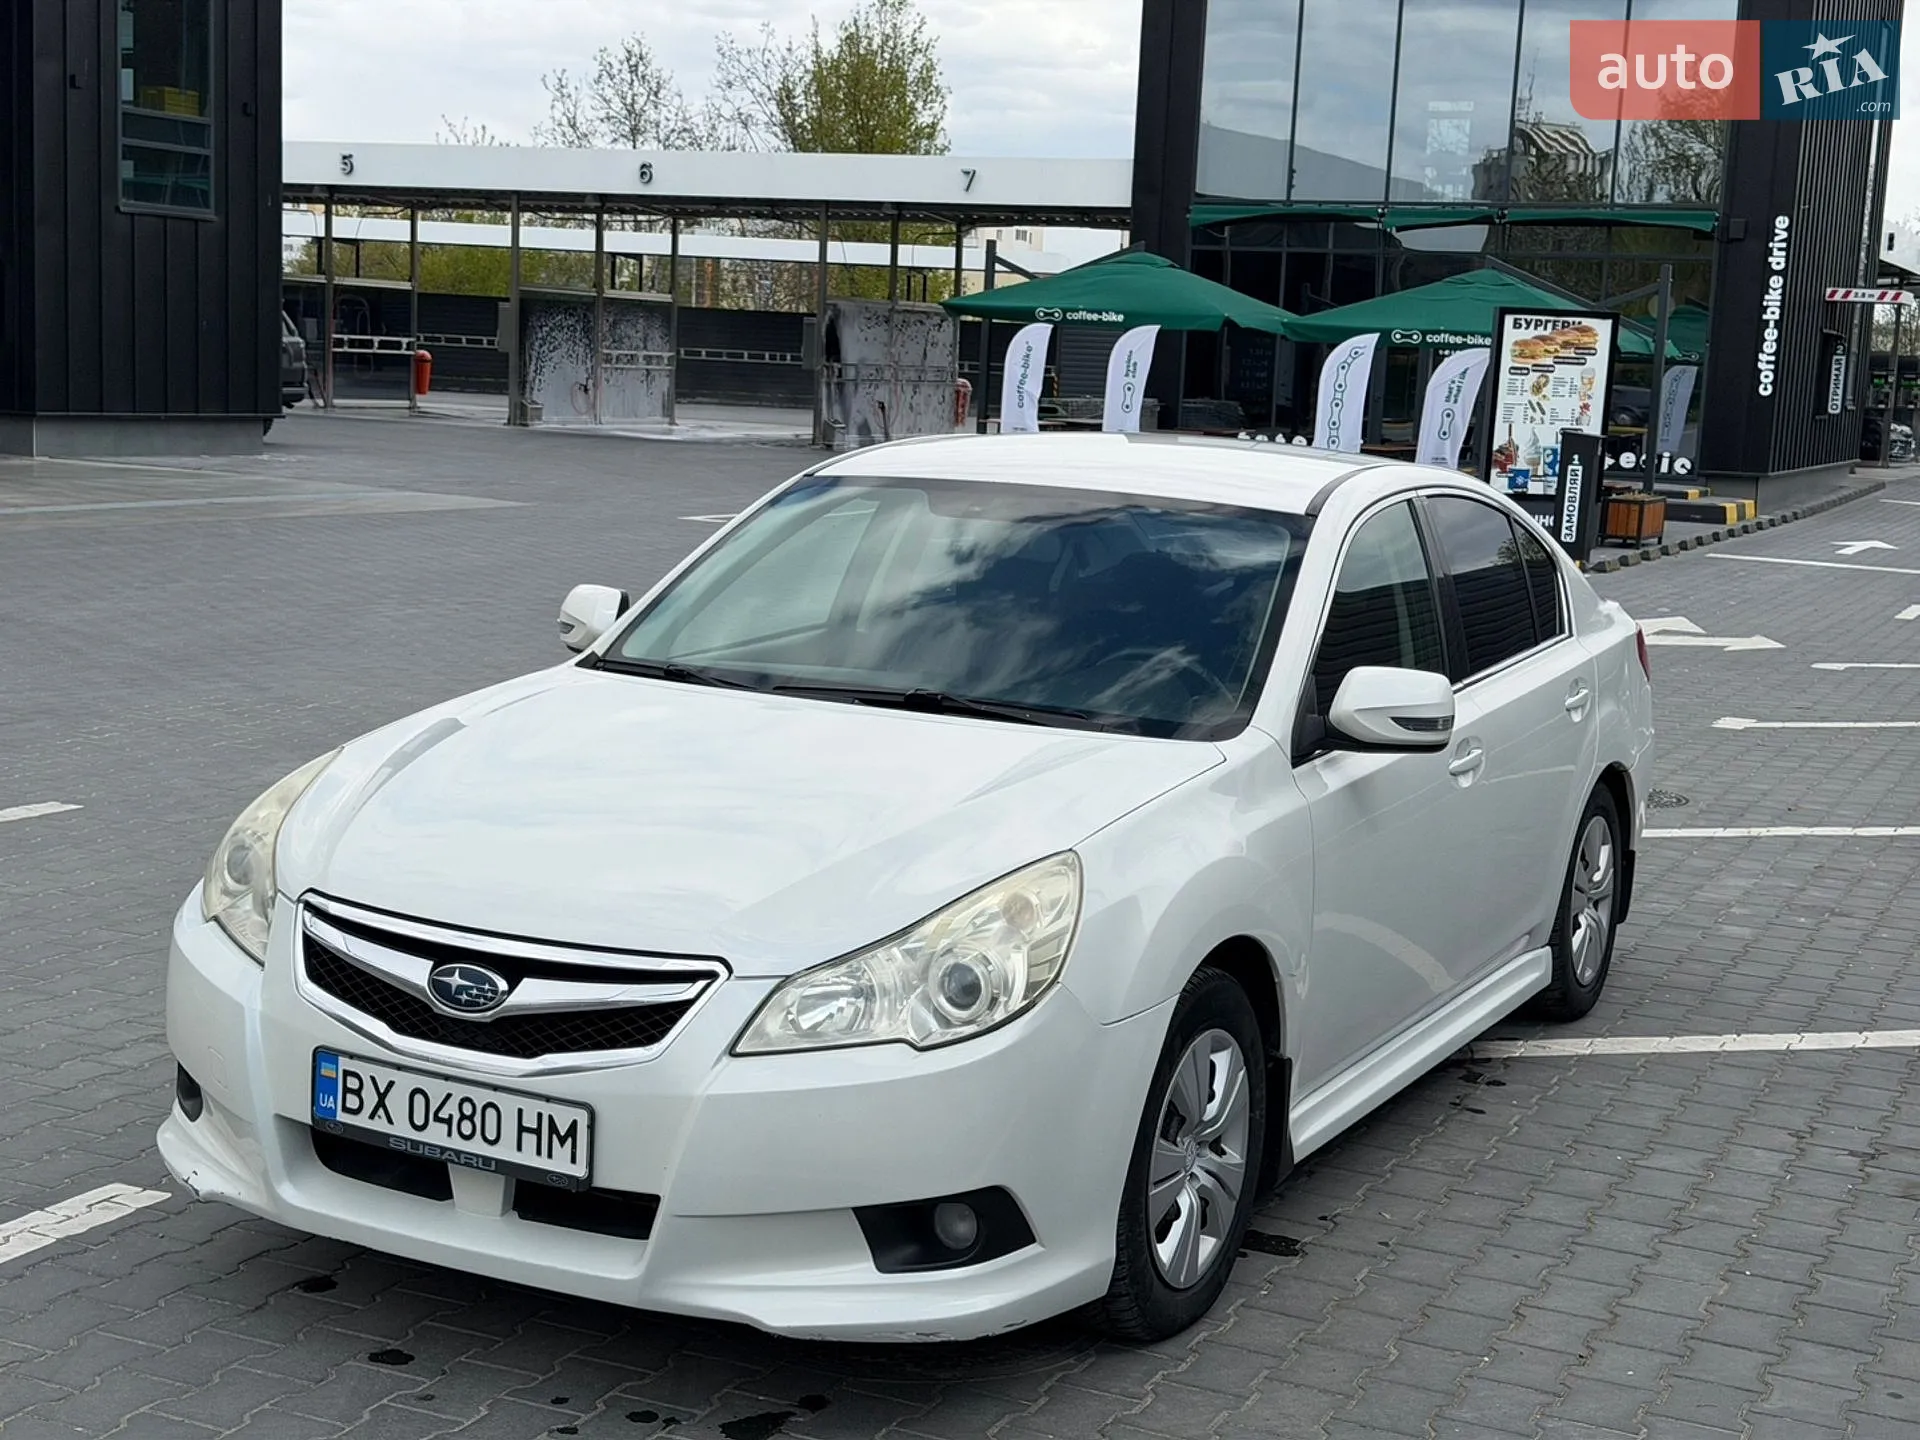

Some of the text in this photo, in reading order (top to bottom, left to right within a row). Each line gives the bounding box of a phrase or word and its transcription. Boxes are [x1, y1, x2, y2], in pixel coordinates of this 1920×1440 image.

[341, 154, 354, 175] 5
[640, 162, 653, 184] 6
[961, 169, 976, 191] 7
[1066, 310, 1124, 322] coffee-bike
[1757, 215, 1790, 396] coffee-bike drive
[1426, 333, 1492, 345] coffee-bike
[319, 1092, 336, 1110] UA
[341, 1068, 578, 1164] BX 0480 HM
[389, 1136, 497, 1171] SUBARU
